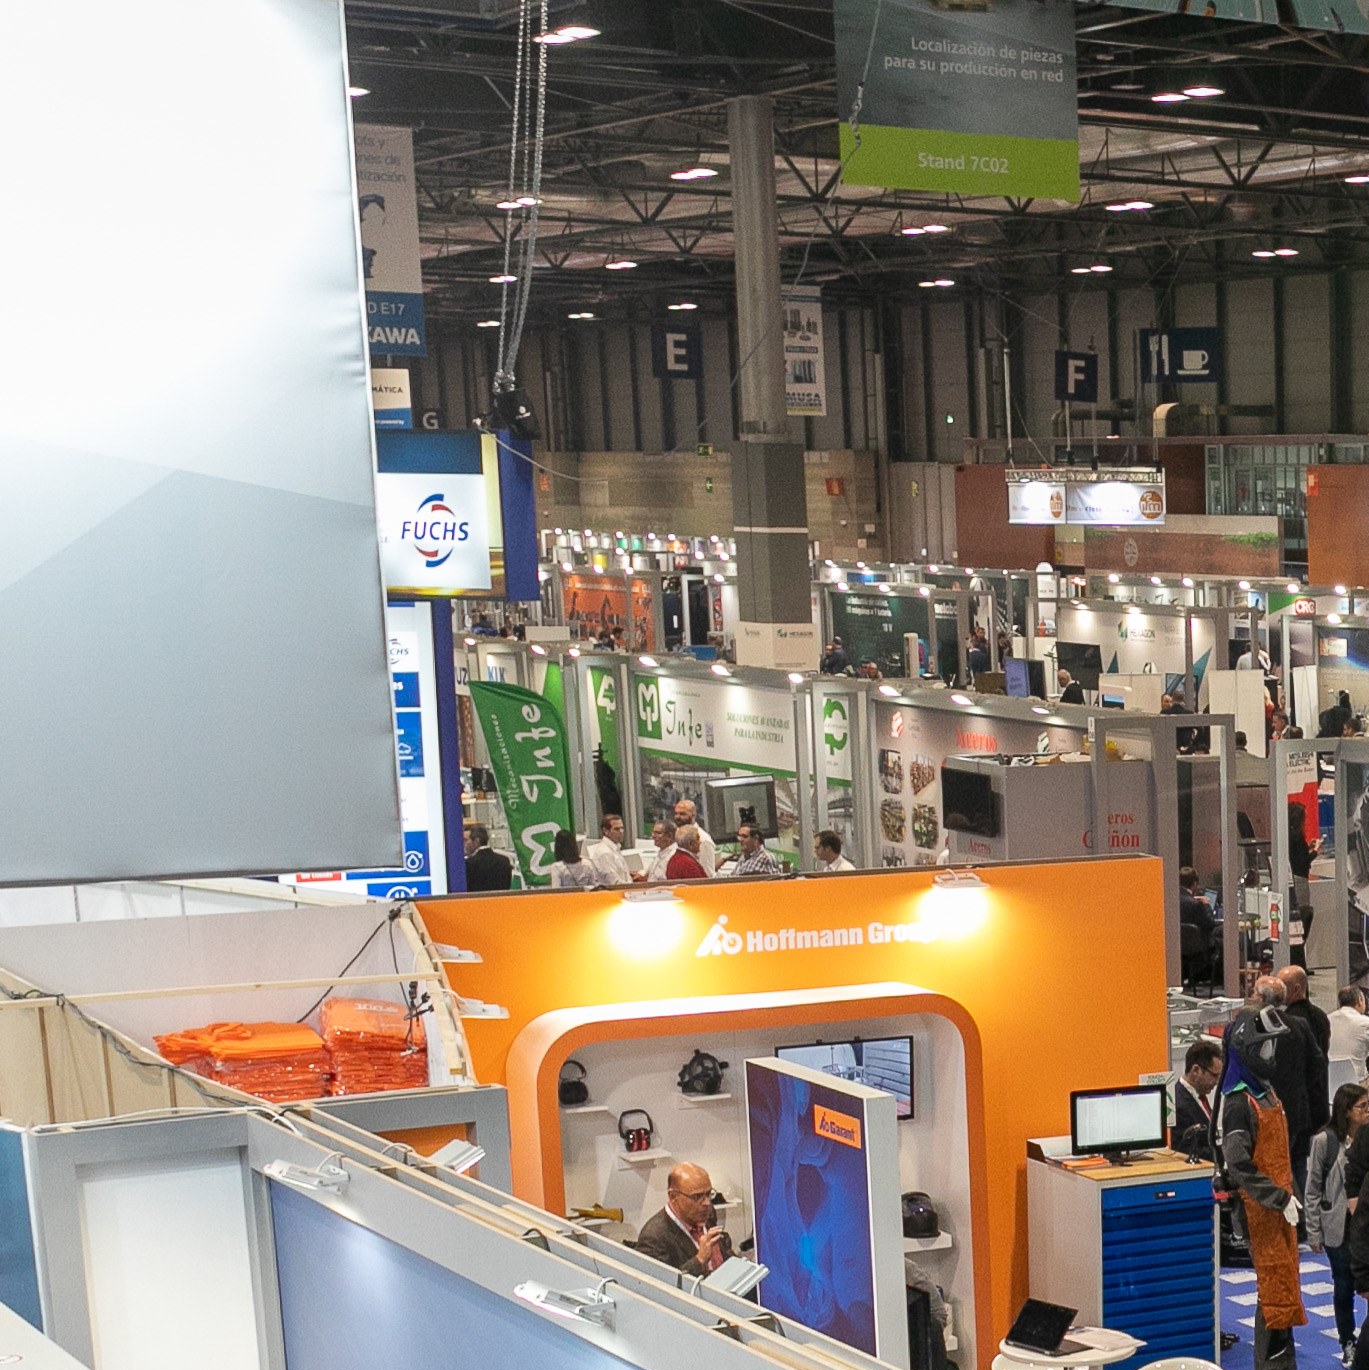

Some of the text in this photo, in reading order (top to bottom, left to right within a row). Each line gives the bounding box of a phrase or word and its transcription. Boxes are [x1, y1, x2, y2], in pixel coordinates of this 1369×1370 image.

[911, 36, 1064, 65] Localización de piezas
[884, 54, 1064, 83] para su producción en red
[918, 152, 1009, 174] Stand 7C02
[664, 332, 690, 371] E
[1068, 358, 1086, 394] F
[401, 520, 469, 541] FUCHS
[1130, 630, 1156, 639] HEXAGON
[956, 726, 998, 752] Aceros
[746, 927, 864, 952] Hoffmann
